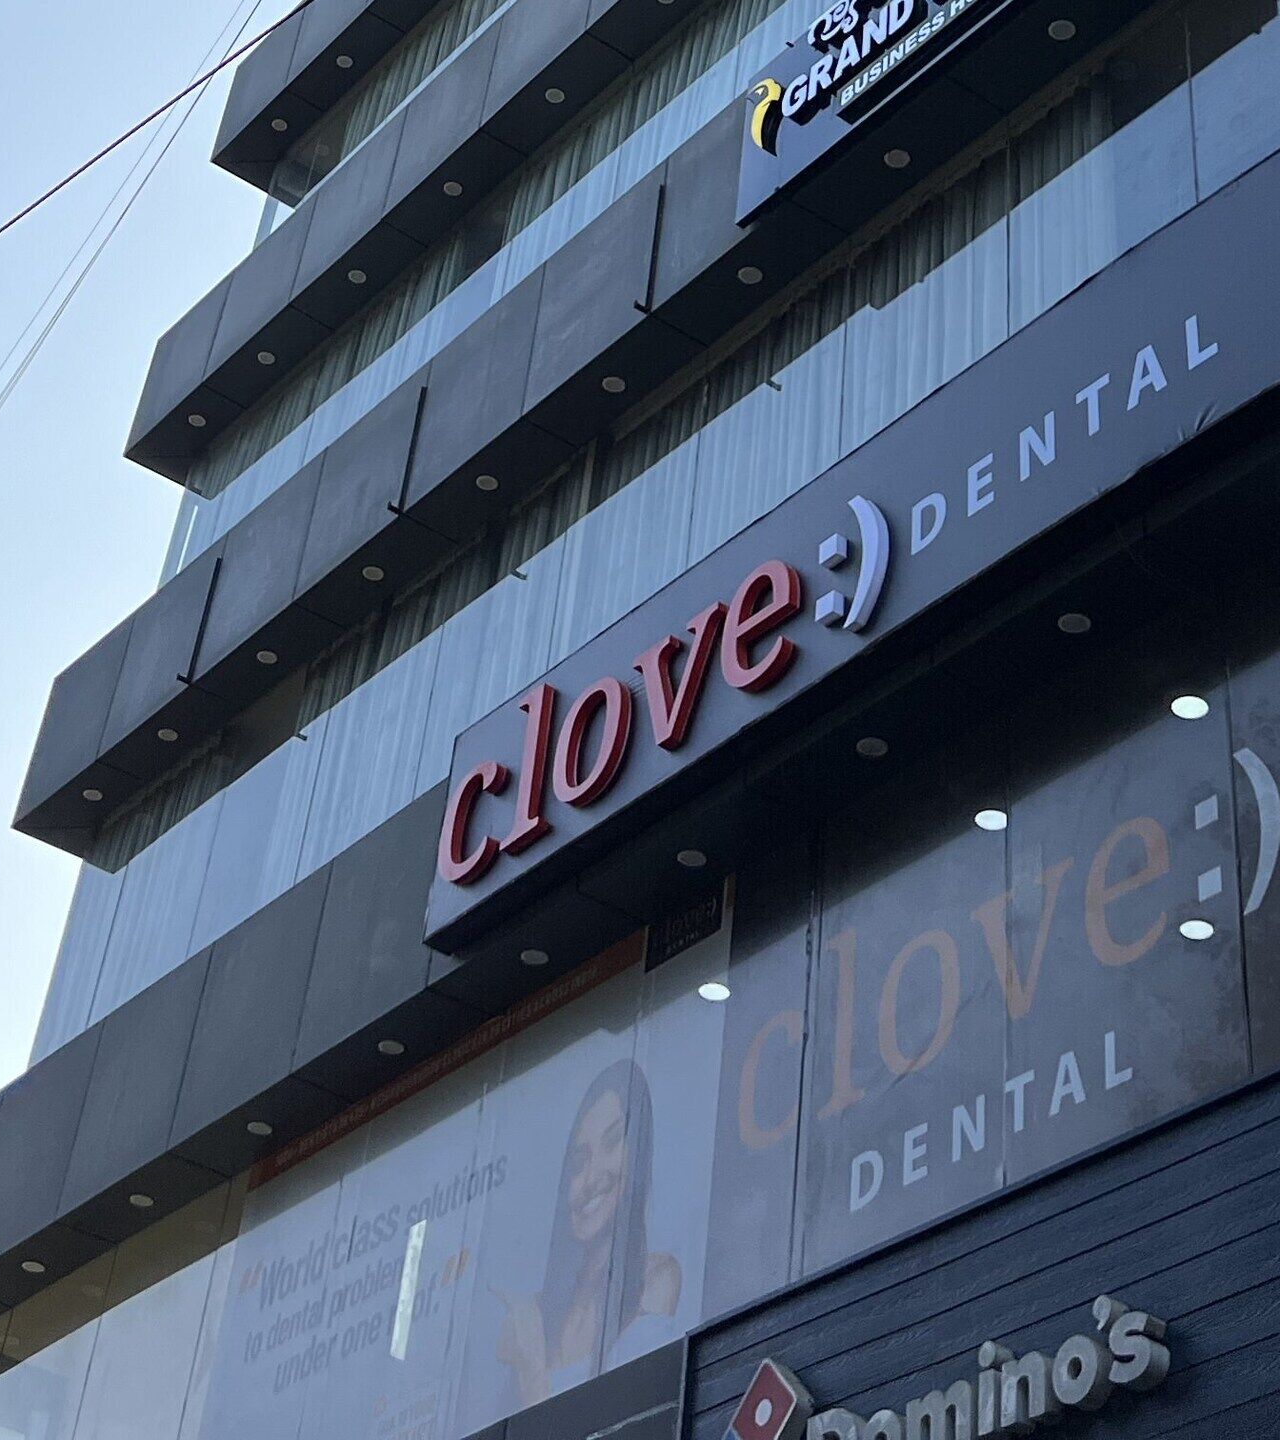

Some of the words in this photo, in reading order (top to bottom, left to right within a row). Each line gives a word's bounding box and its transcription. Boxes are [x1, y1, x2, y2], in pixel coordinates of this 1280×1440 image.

[839, 11, 946, 107] BUSINESS
[910, 314, 1220, 556] DENTAL
[850, 1030, 1133, 1212] DENTAL
[334, 1202, 400, 1269] class
[406, 1155, 508, 1237] solutions
[273, 1333, 338, 1396] under
[341, 1312, 381, 1359] one
